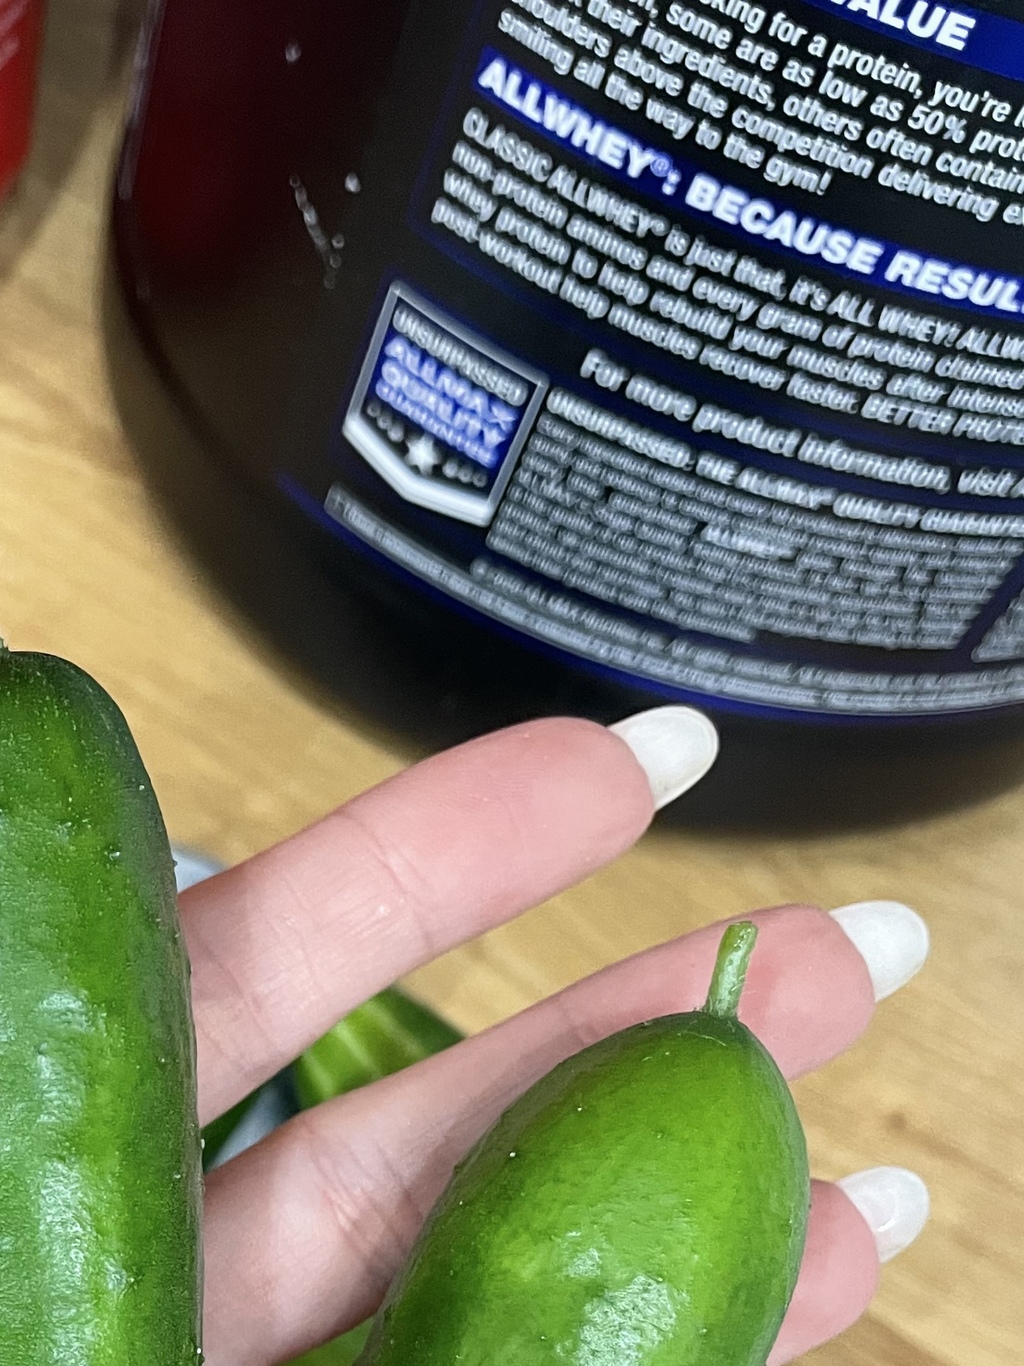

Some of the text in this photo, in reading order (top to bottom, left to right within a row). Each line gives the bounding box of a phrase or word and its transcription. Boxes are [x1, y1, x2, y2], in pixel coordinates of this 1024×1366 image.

[498, 7, 833, 196] smiling all the way to the gym!
[586, 0, 643, 37] their
[642, 20, 775, 112] ingredients,
[782, 93, 864, 141] others
[866, 127, 933, 166] often
[666, 2, 733, 50] some
[735, 37, 779, 72] are
[781, 57, 815, 87] as
[818, 70, 868, 108] low
[869, 94, 904, 122] as
[907, 103, 968, 144] 50%
[768, 11, 808, 47] for
[807, 33, 827, 58] a
[827, 43, 923, 99] protein,
[927, 80, 1011, 123] you're
[833, 0, 976, 51] ALUE
[614, 44, 684, 97] above
[687, 79, 730, 119] the
[731, 104, 874, 180] competition
[877, 162, 1000, 222] delivering
[452, 139, 568, 229] non-protein
[566, 214, 648, 270] aminos
[646, 254, 696, 292] and
[692, 276, 761, 321] every
[756, 302, 823, 341] gram
[821, 324, 857, 350] of
[848, 332, 937, 374] protein
[463, 106, 553, 183] CLASSIC
[664, 223, 691, 257] is
[683, 235, 739, 277] just
[788, 274, 831, 312] it's
[827, 289, 876, 327] ALL
[877, 304, 963, 348] WHEY!
[495, 206, 571, 265] protein
[572, 248, 598, 279] to
[598, 260, 650, 306] help
[650, 289, 734, 340] rebuild
[728, 324, 789, 360] your
[787, 343, 887, 391] muscles
[684, 172, 884, 275] BECAUSE
[884, 249, 1024, 313] RESUL
[559, 272, 611, 320] help
[607, 302, 702, 360] muscles
[699, 343, 789, 391] recover
[860, 392, 959, 435] BETTER
[580, 348, 629, 392] For
[626, 374, 697, 421] more
[692, 403, 802, 457] product
